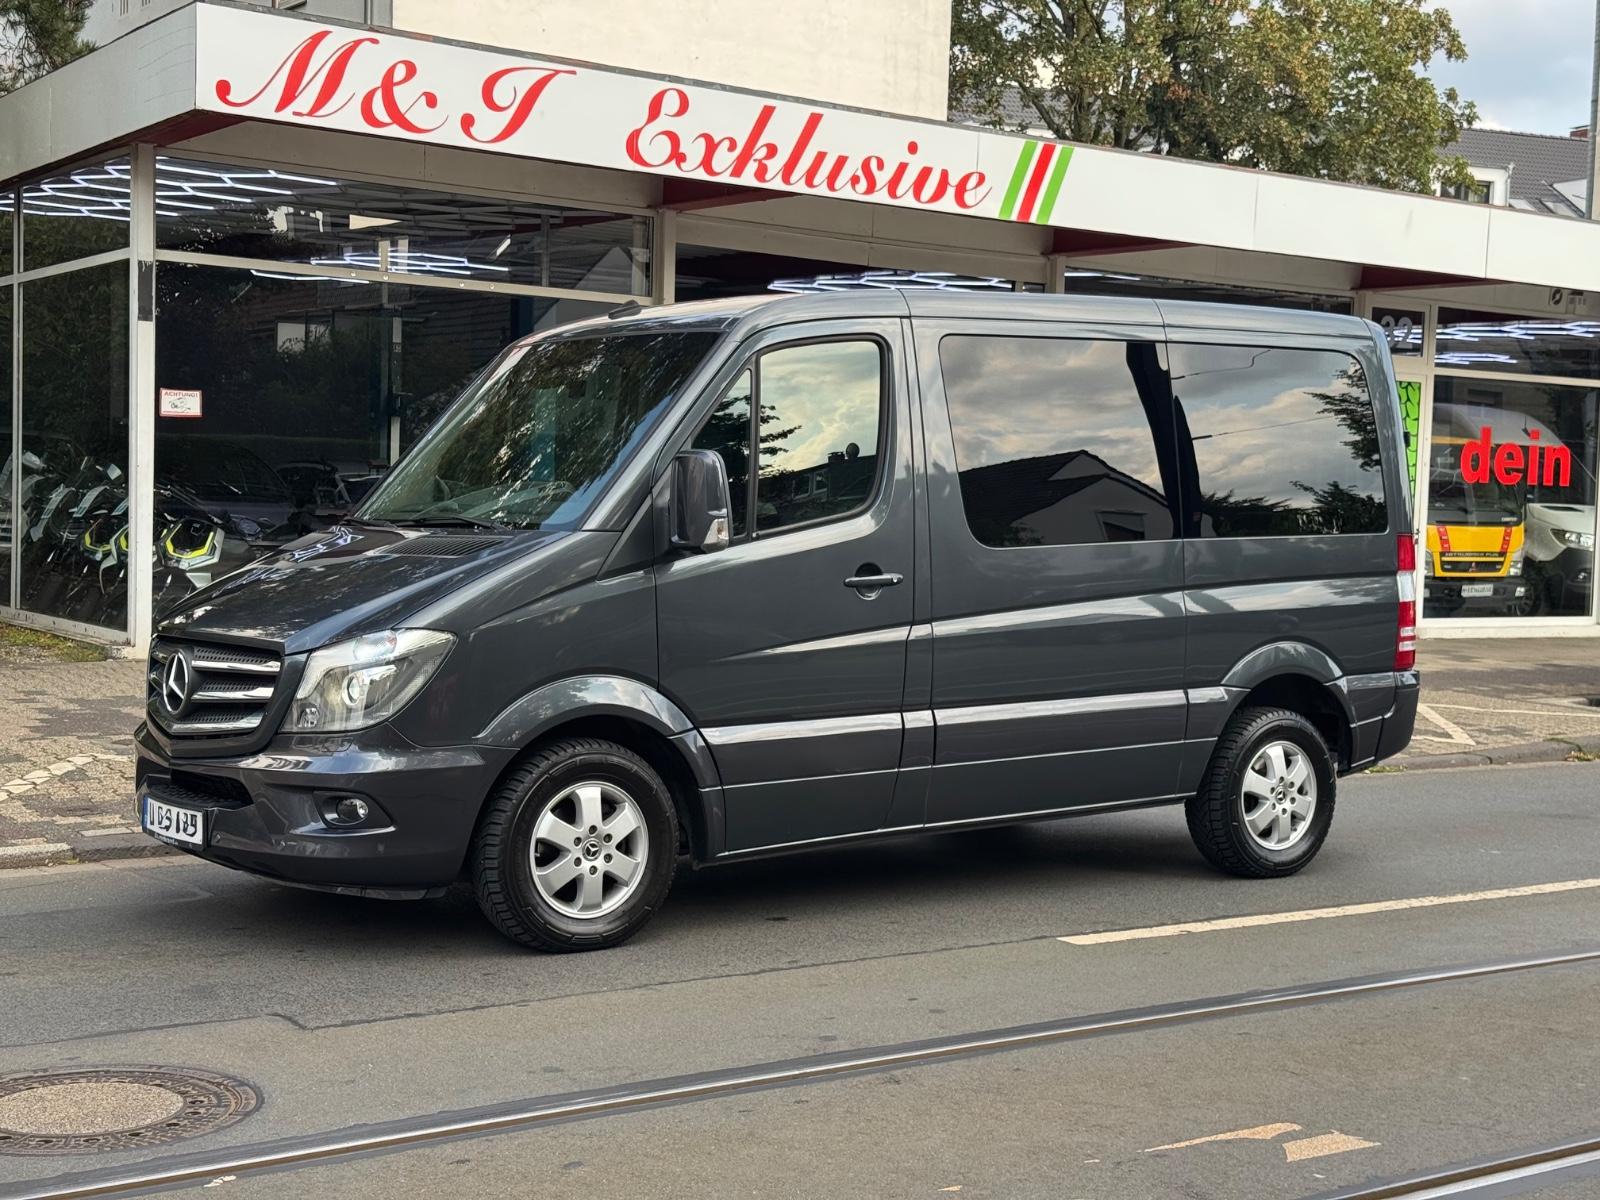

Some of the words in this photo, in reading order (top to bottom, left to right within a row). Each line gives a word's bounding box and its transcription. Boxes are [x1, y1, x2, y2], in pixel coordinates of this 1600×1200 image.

[214, 29, 381, 119] M
[359, 58, 450, 135] &
[624, 87, 993, 211] Exklusive
[1460, 426, 1571, 487] dein
